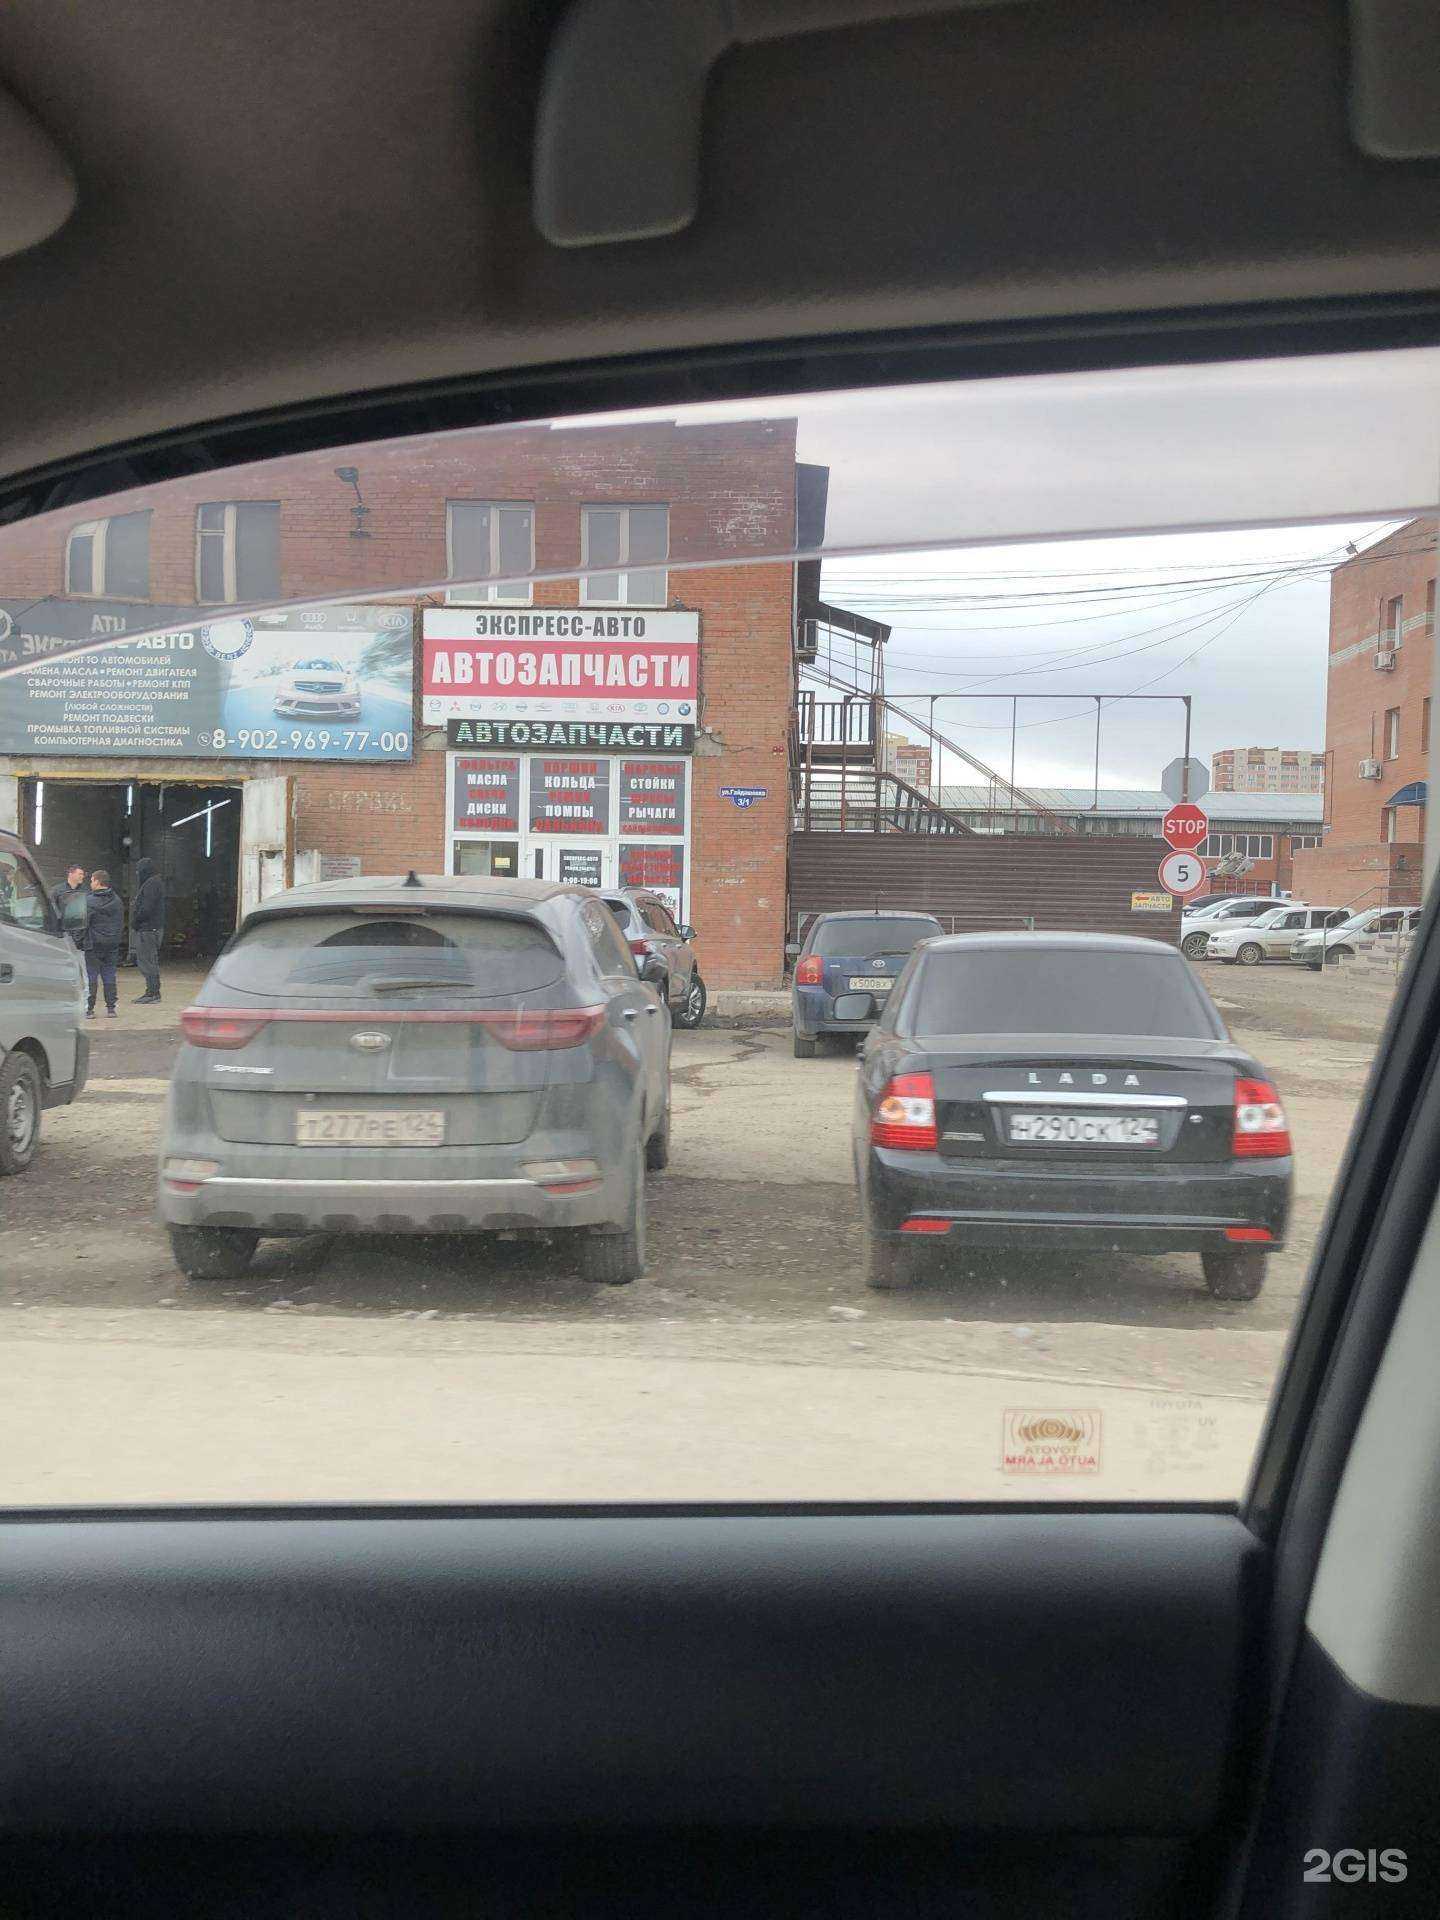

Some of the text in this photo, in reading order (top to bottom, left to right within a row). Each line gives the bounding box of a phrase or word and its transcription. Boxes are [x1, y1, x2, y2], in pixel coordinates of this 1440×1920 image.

[476, 615, 646, 637] ЭКСПРЕСС-АВТО
[101, 655, 171, 665] АВТОМОБИЛЕЙ
[62, 667, 98, 676] МАСЛА
[106, 667, 143, 677] РЕМОНТ
[145, 668, 197, 678] ДВИГАТЕЛЯ
[431, 652, 690, 687] АВТОЗАПЧАСТИ
[27, 678, 191, 689] СВАРОЧНЫЕ РАБОТЫ РЕМОНТ КПП
[29, 690, 189, 700] РЕМОНТ ЭЛЕКТРООБОРУДОВАНИЯ
[63, 713, 154, 723] РЕМОНТ ПОДВЕСКИ
[27, 724, 190, 735] ПРОМЫВКА ТОПЛИВНОЙ СИСТЕМЫ
[456, 722, 682, 746] АВТОЗАПЧАСТИ
[34, 736, 183, 747] КОМПЬЮТЕРНАЯ ДИАГНОСТИКА
[212, 729, 409, 752] 8-902-969-77-00
[467, 774, 508, 785] МАСЛА
[544, 776, 596, 790] КОЛЬЦА
[630, 776, 675, 790] СТОЙКИ
[467, 803, 507, 815] ДИСКИ
[545, 805, 594, 818] ПОМПЫ
[628, 807, 676, 819] РЫЧАГИ
[1166, 820, 1206, 834] STOP
[1177, 865, 1189, 882] 5
[1028, 1072, 1140, 1086] LADA
